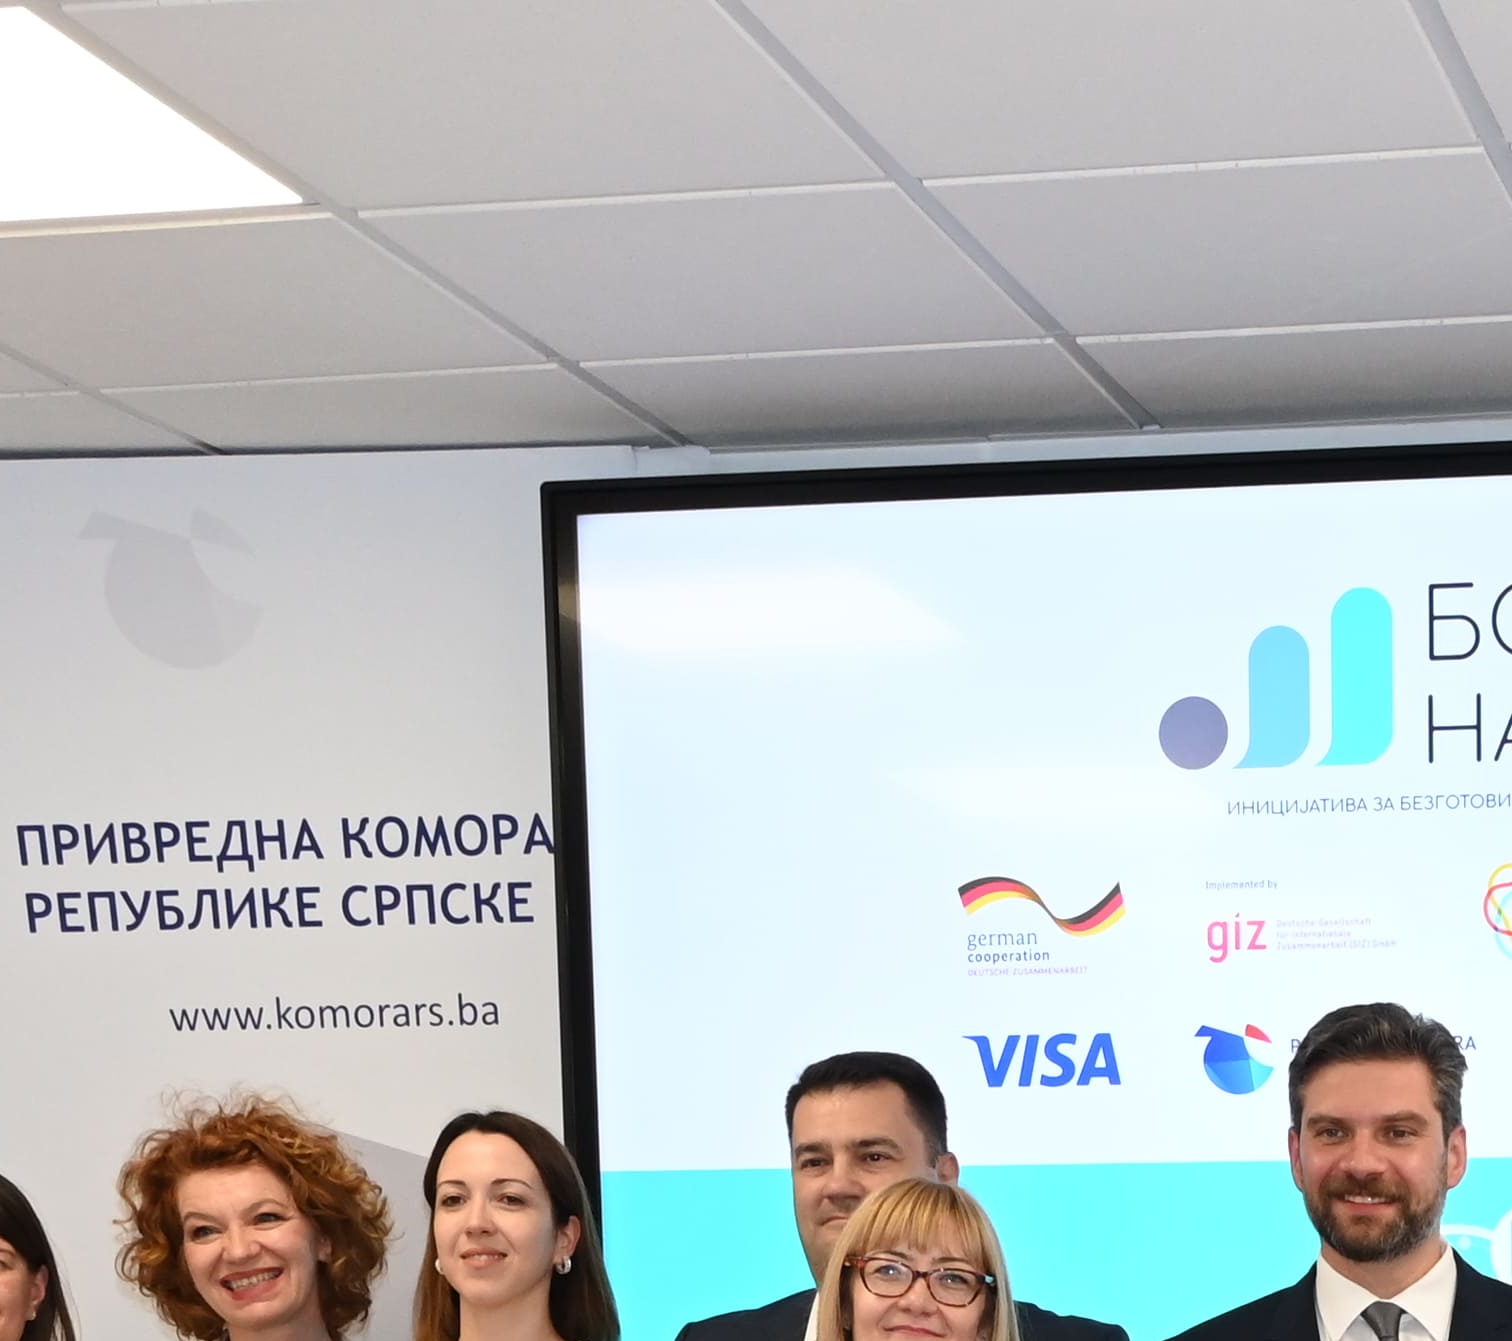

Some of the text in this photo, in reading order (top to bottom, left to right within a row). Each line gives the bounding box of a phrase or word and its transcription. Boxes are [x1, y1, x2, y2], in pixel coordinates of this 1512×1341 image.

[1227, 797, 1368, 816] ИНИЦИЈАТИВА
[1373, 796, 1395, 812] ЗА
[16, 813, 554, 873] ПРИВРЕДНА КОМОРА
[25, 881, 535, 934] РЕПУБЛИКЕ СРПСКЕ
[967, 932, 1038, 951] german
[967, 949, 1050, 965] cooperation
[1207, 912, 1267, 963] giz
[169, 993, 500, 1033] www.komorars.ba
[962, 1032, 1122, 1088] VISA
